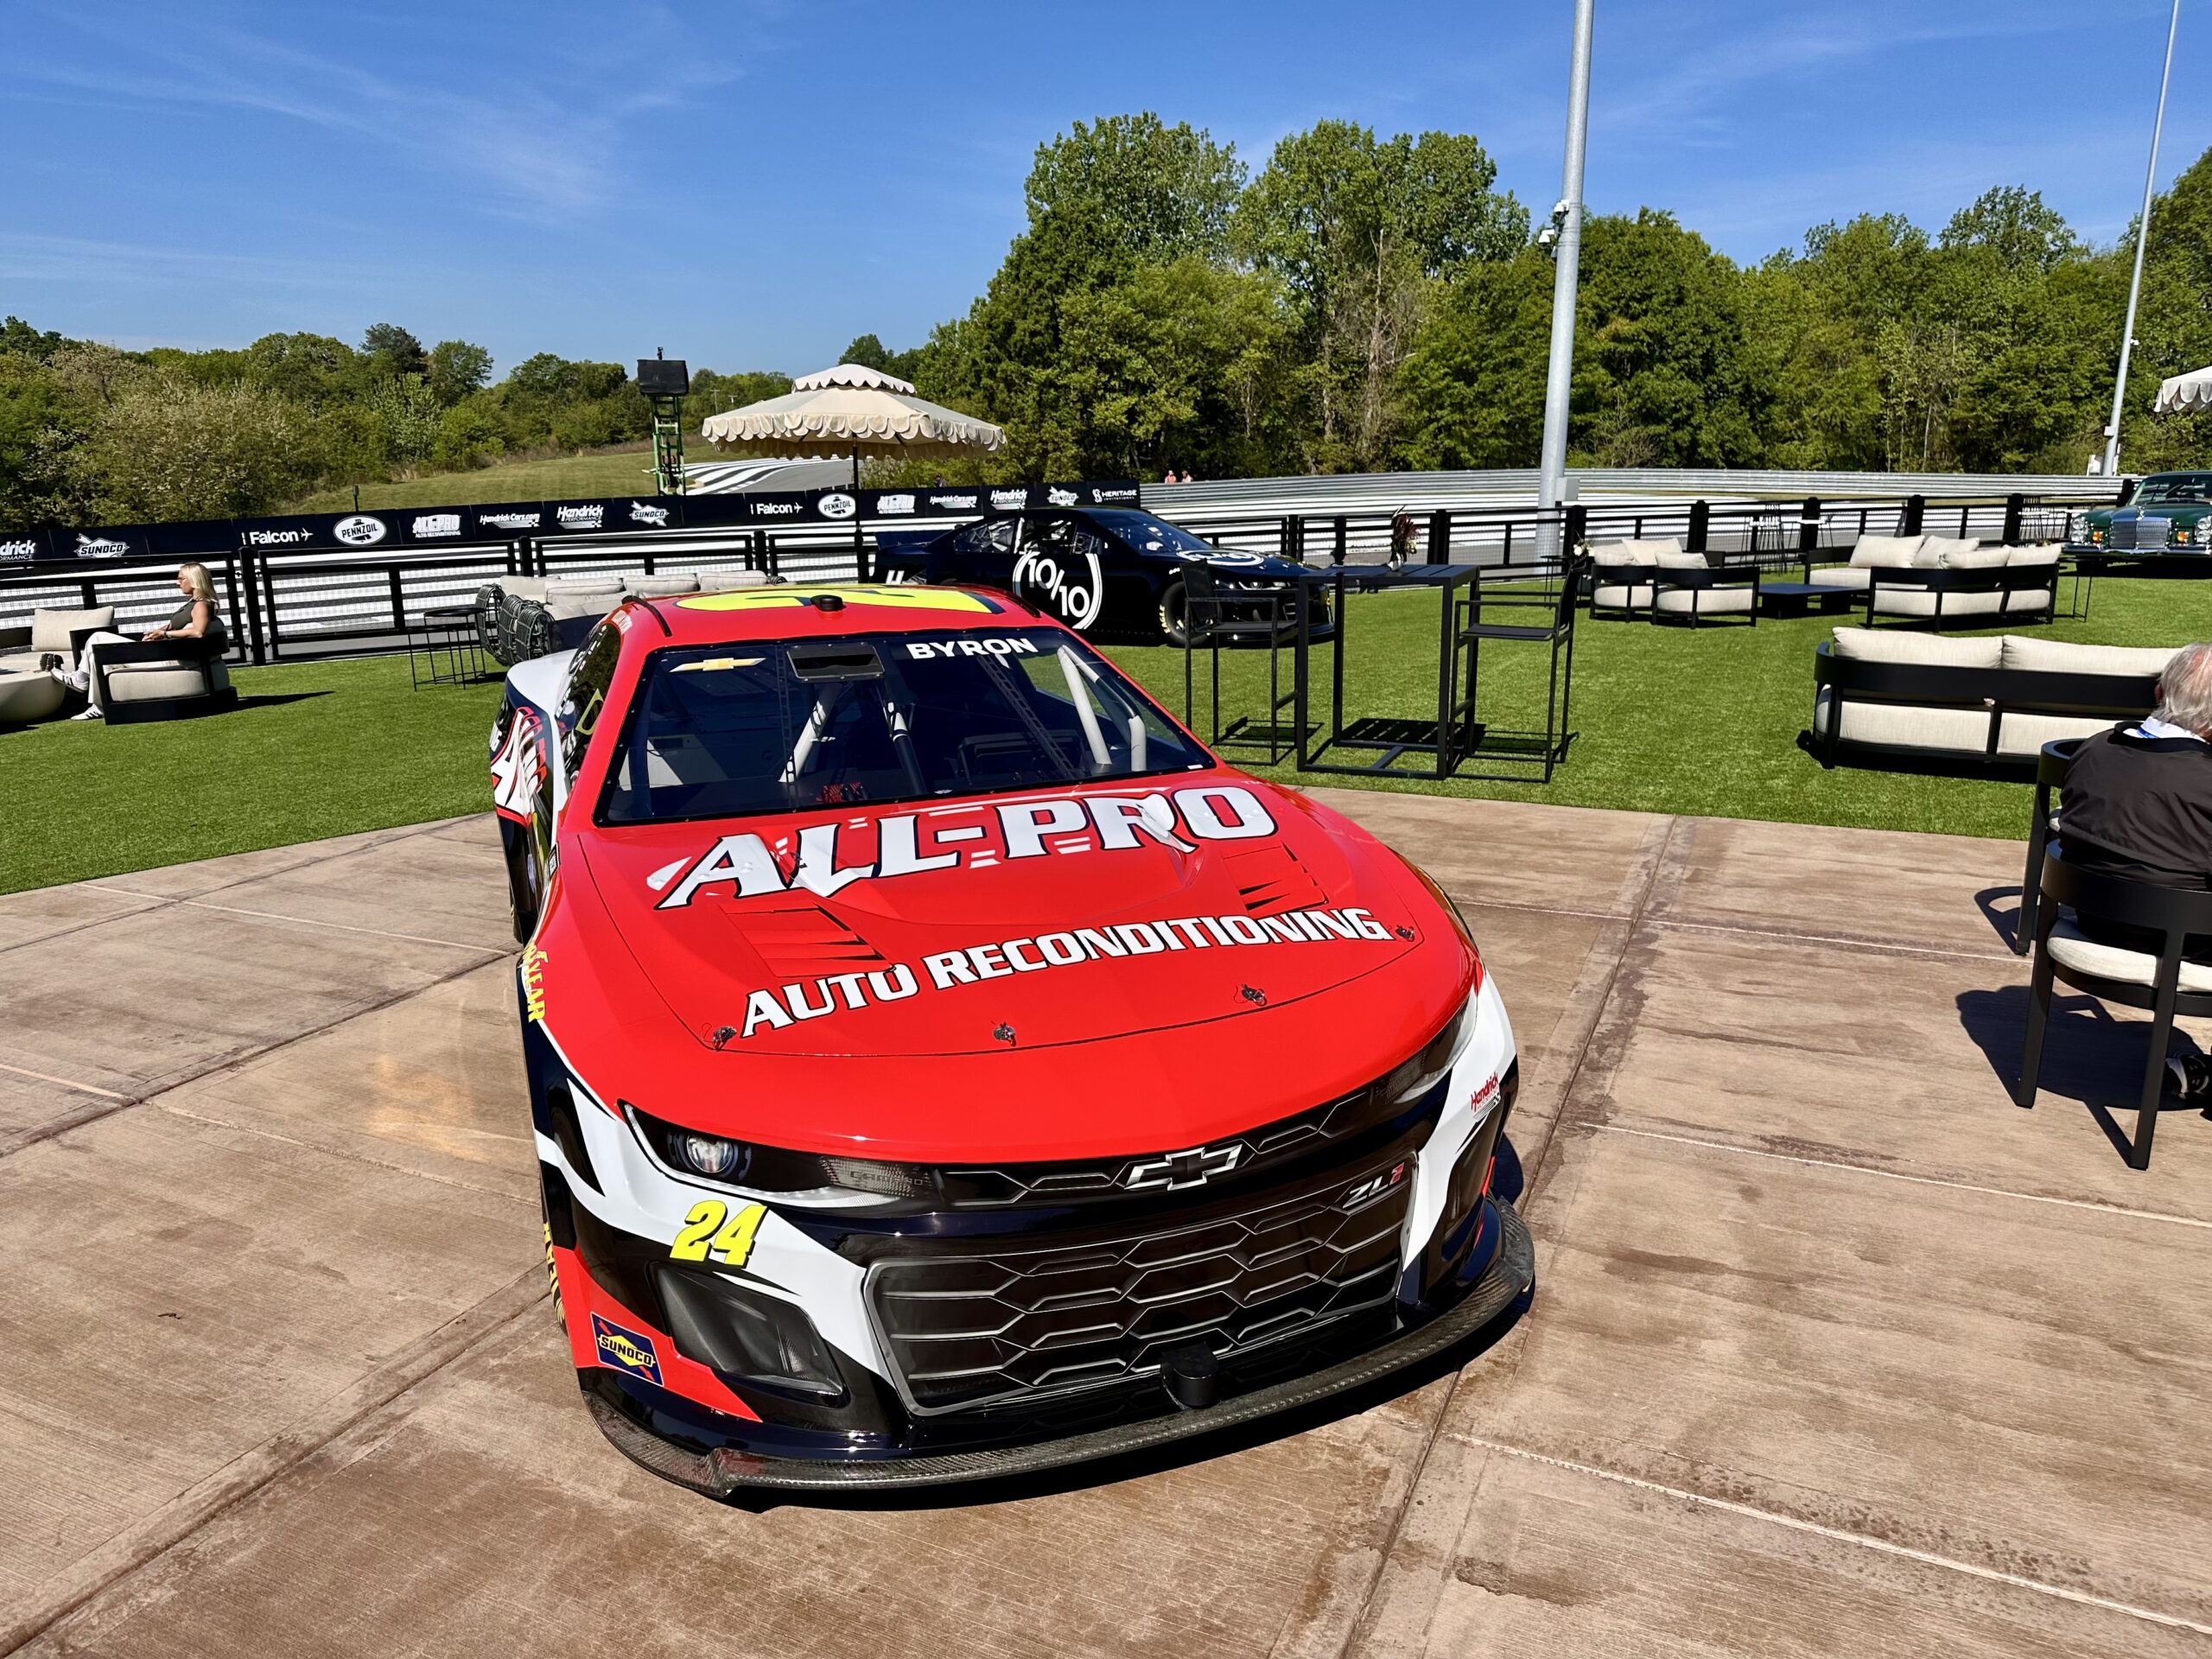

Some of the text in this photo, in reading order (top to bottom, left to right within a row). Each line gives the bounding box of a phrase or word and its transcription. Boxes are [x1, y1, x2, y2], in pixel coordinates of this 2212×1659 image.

[990, 489, 1027, 503] Hendrick
[1102, 489, 1137, 498] HERITAGE
[556, 505, 604, 521] Hendrick
[756, 503, 792, 514] Falcon
[823, 499, 852, 512] PENNZOIL
[249, 531, 299, 544] Falcon
[341, 523, 378, 538] PENNZOIL
[0, 540, 36, 556] drick
[80, 544, 123, 555] SUNOCO
[906, 638, 1039, 659] BYRON
[653, 786, 1278, 910] ALL-PRO
[741, 907, 1395, 1038] AUTO RECONDITIONING
[1471, 1071, 1499, 1112] Hendrick
[1342, 1162, 1405, 1209] ZL1
[670, 1199, 769, 1268] 24
[601, 1336, 652, 1366] SUNOCO
